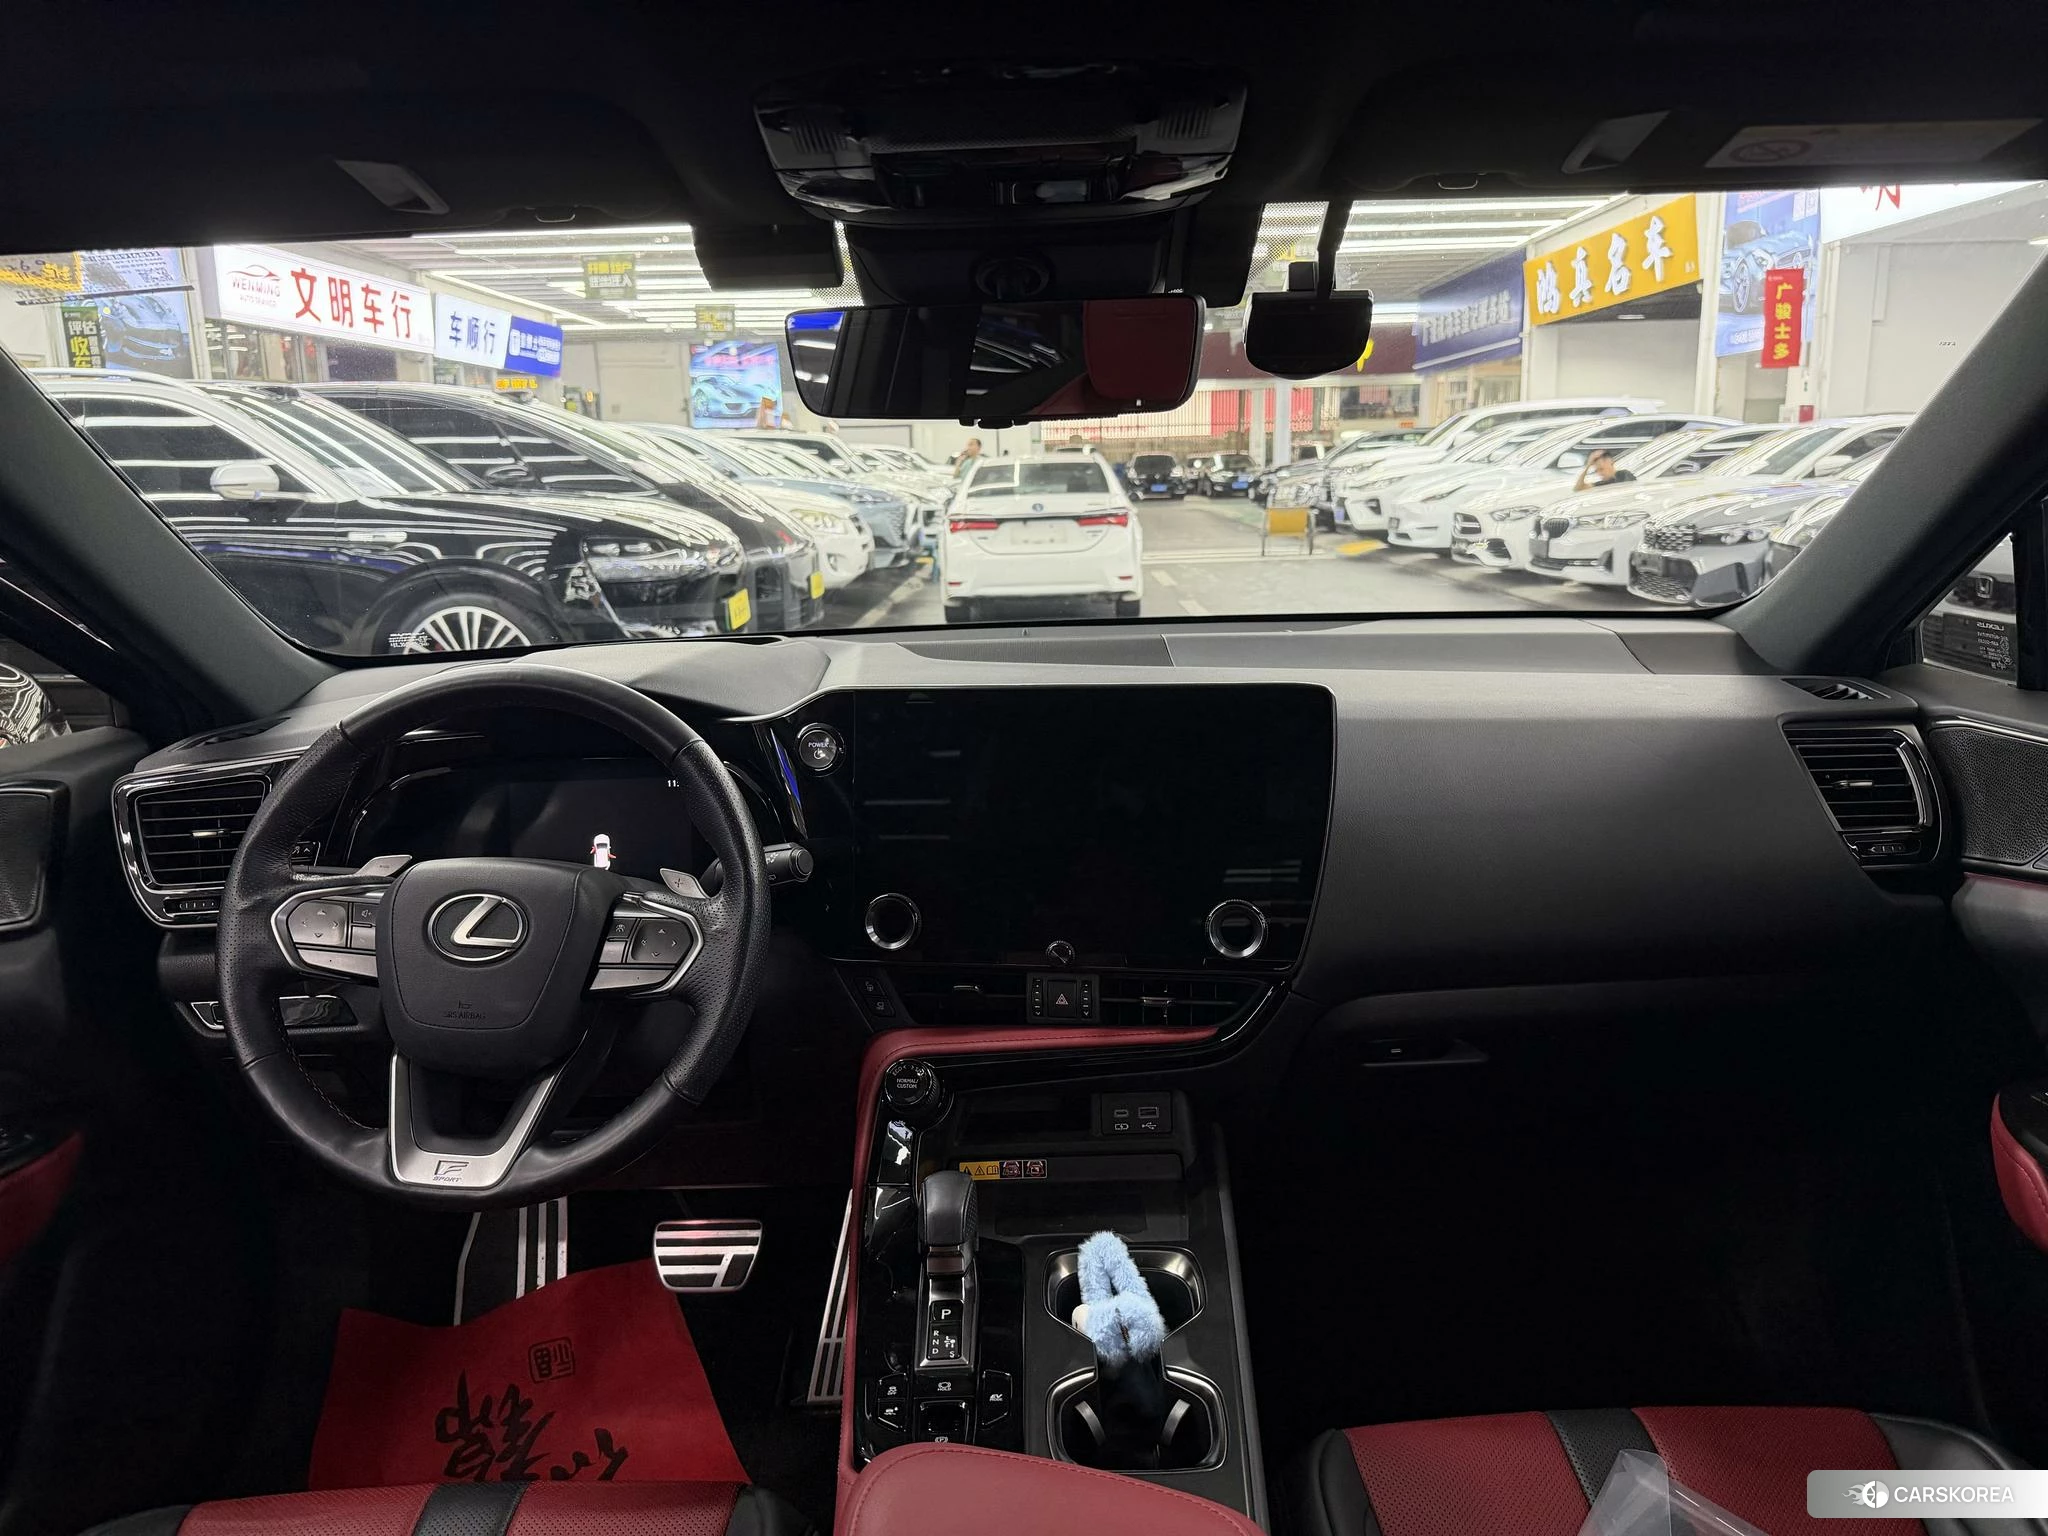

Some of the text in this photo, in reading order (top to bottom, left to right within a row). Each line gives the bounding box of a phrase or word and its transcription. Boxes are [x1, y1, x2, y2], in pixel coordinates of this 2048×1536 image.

[290, 268, 413, 339] 文明车行
[941, 1308, 952, 1320] P
